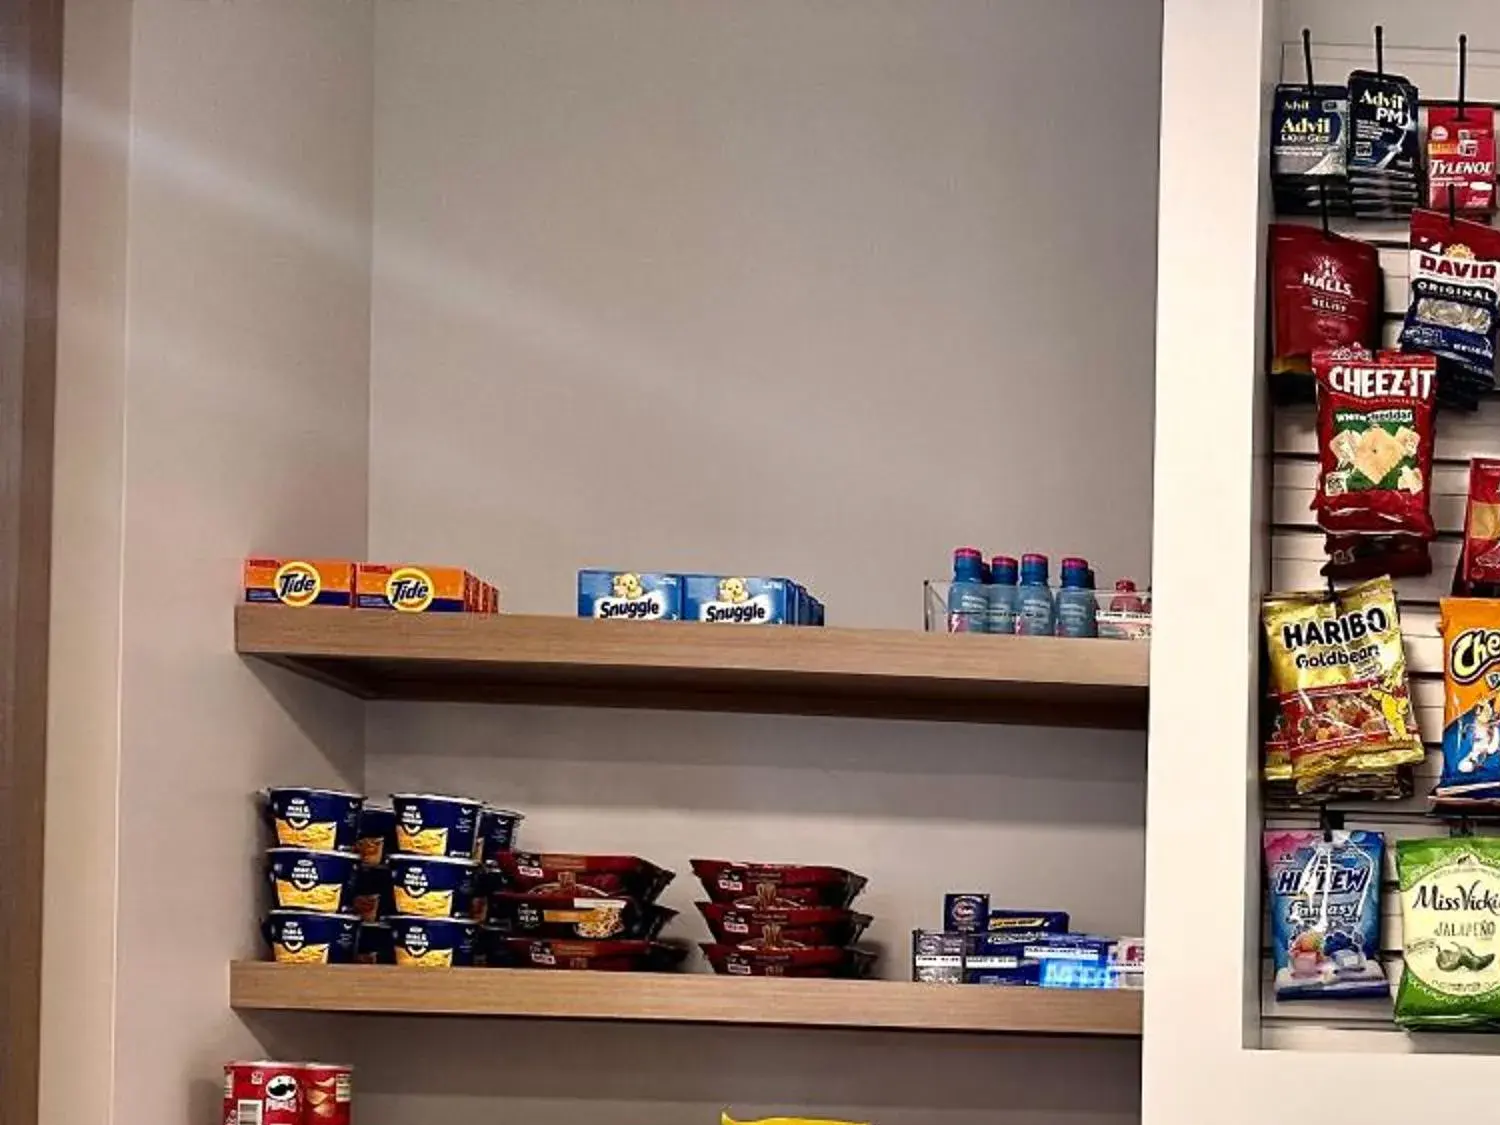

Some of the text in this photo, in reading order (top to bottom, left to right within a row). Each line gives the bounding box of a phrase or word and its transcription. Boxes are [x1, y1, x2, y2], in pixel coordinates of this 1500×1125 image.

[1360, 89, 1403, 109] Advil
[1281, 118, 1331, 133] Advil
[1376, 107, 1403, 124] PM
[1430, 159, 1493, 176] TYLENOL
[1419, 254, 1496, 279] DAVID
[1302, 272, 1352, 296] HALLS
[1417, 280, 1491, 301] ORIGINAL
[1328, 366, 1436, 400] CHEEZ-IT
[279, 573, 317, 597] Tide
[391, 581, 429, 601] Tide
[600, 599, 660, 619] Snuggle
[706, 604, 766, 624] Snuggle
[1282, 607, 1388, 649] HARIBO
[1413, 884, 1459, 911] Miss
